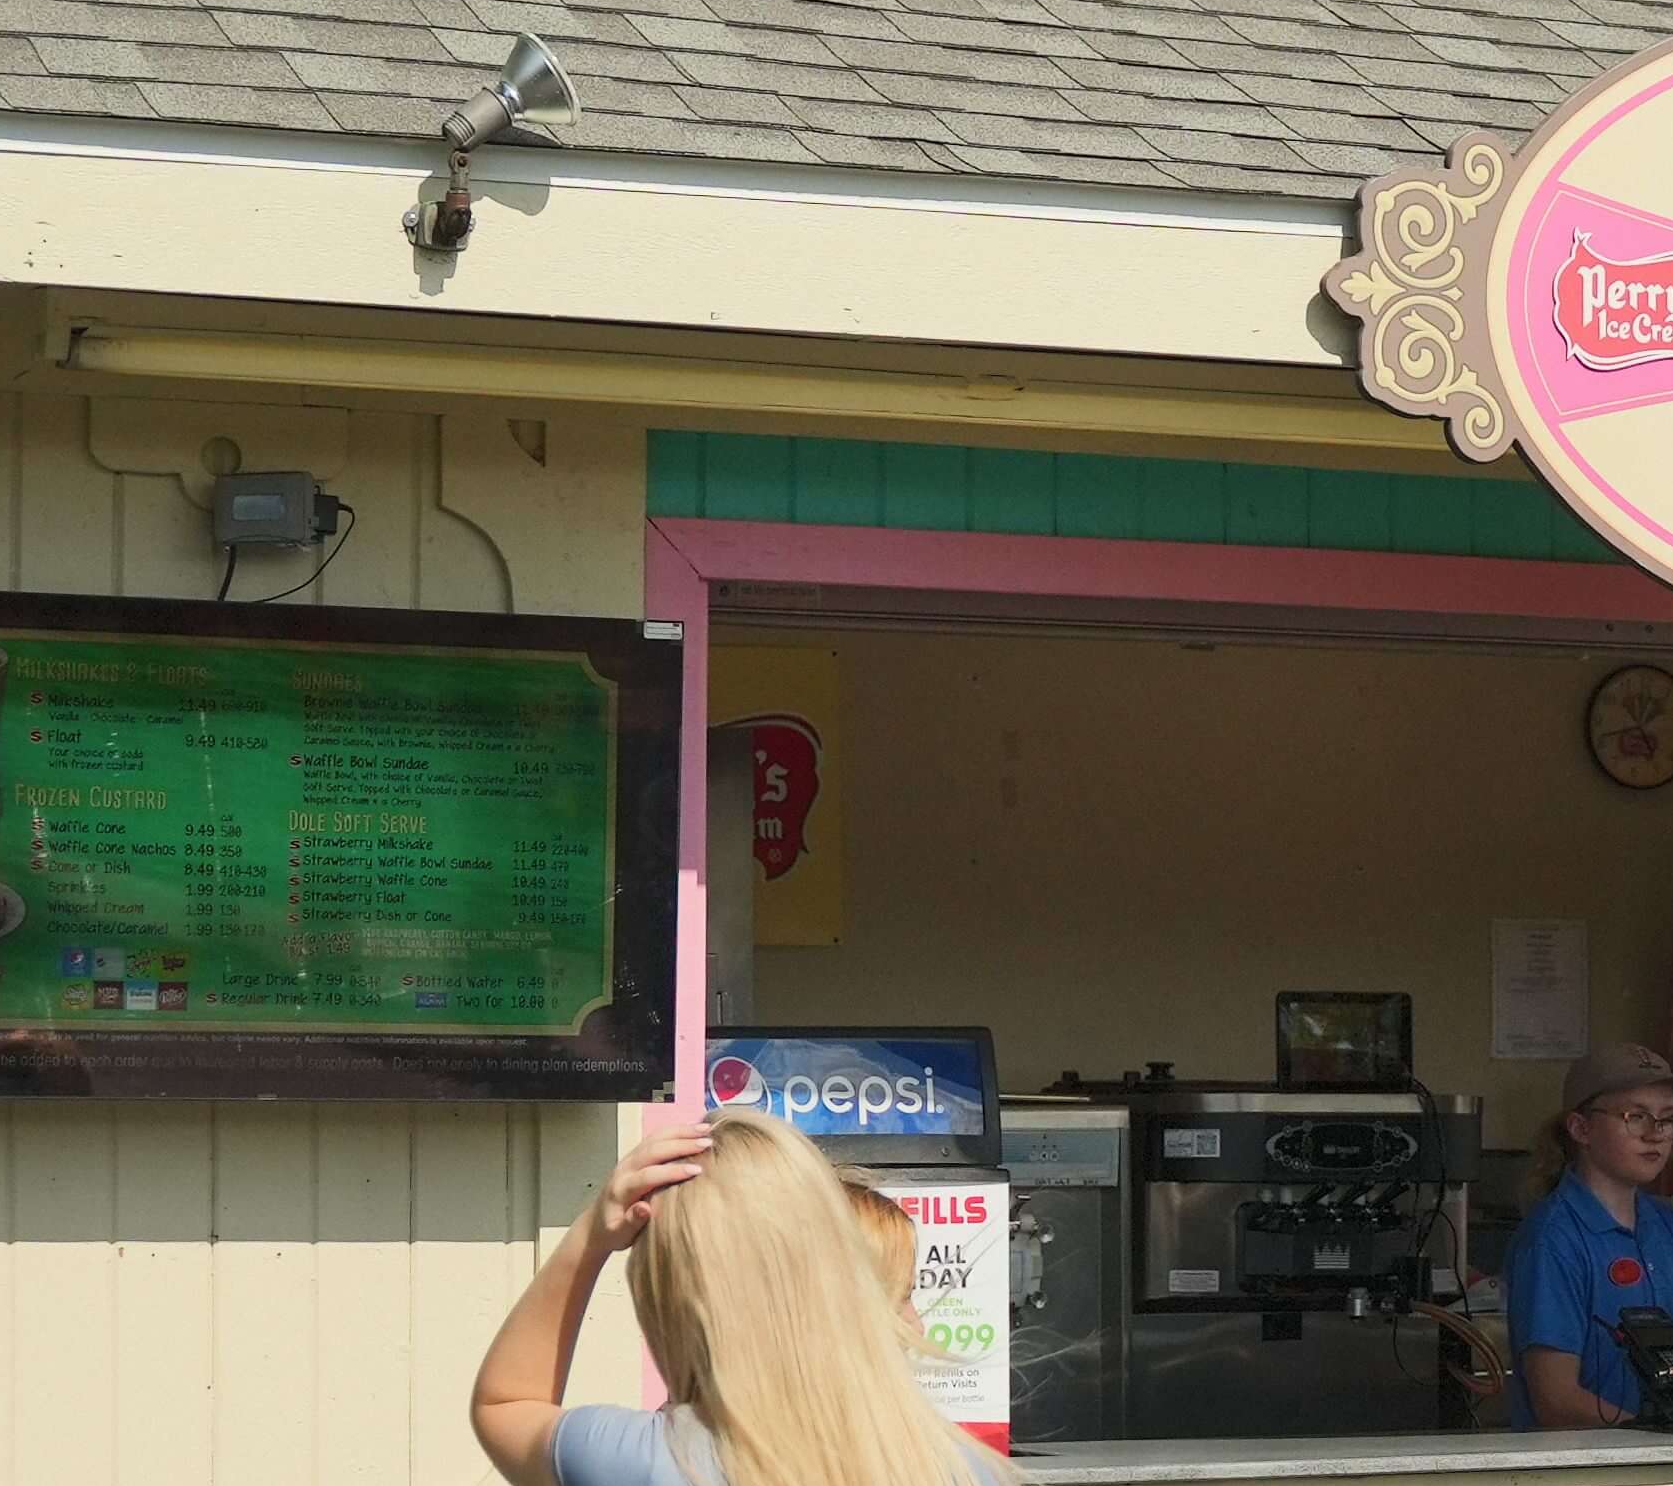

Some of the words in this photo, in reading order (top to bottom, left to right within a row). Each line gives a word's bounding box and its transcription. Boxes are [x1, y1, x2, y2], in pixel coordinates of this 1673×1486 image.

[1598, 309, 1630, 340] Ice
[47, 730, 81, 744] Float
[185, 736, 215, 748] 9.49
[304, 754, 343, 768] Waffle
[350, 755, 377, 768] Bowl
[383, 757, 429, 769] Sundae
[15, 784, 80, 807] FROZEN
[90, 786, 167, 810] CUSTARD
[288, 809, 325, 832] DOLE
[333, 812, 372, 833] SOFT
[380, 814, 428, 833] SERVE
[49, 821, 89, 833] Waffle
[95, 822, 126, 834] Cone
[185, 825, 215, 837] 9.49
[49, 841, 88, 854] Waffle
[95, 843, 125, 855] Cone
[131, 843, 176, 855] Nachos
[184, 844, 215, 857] 8.49
[303, 837, 373, 851] Strawberry
[377, 838, 433, 850] Milkshake
[104, 862, 131, 874] Dish
[184, 865, 215, 877] 8.49
[303, 855, 373, 869] Strawberry
[377, 856, 415, 869] Waffle
[420, 857, 445, 870] Bowl
[450, 859, 495, 871] Sundae
[303, 873, 373, 887] Strawberry
[377, 874, 415, 886] Waffle
[420, 875, 447, 887] Cone
[185, 884, 214, 897] 1.99
[303, 891, 372, 906] Strawberry
[376, 892, 407, 904] Float
[302, 909, 371, 923] Strawberry
[376, 910, 402, 922] Dish
[406, 913, 418, 922] or
[424, 911, 452, 923] Cone
[223, 973, 260, 986] Large
[467, 977, 503, 989] Water
[456, 997, 480, 1009] Two
[501, 1057, 539, 1074] dining
[542, 1058, 568, 1074] plan
[571, 1057, 648, 1074] redemptions.
[784, 1067, 934, 1126] pepsi
[896, 1196, 987, 1224] FILLS
[926, 1245, 966, 1264] ALL
[920, 1268, 972, 1289] DAY
[953, 1308, 981, 1317] ONLY
[951, 1380, 977, 1388] Visits
